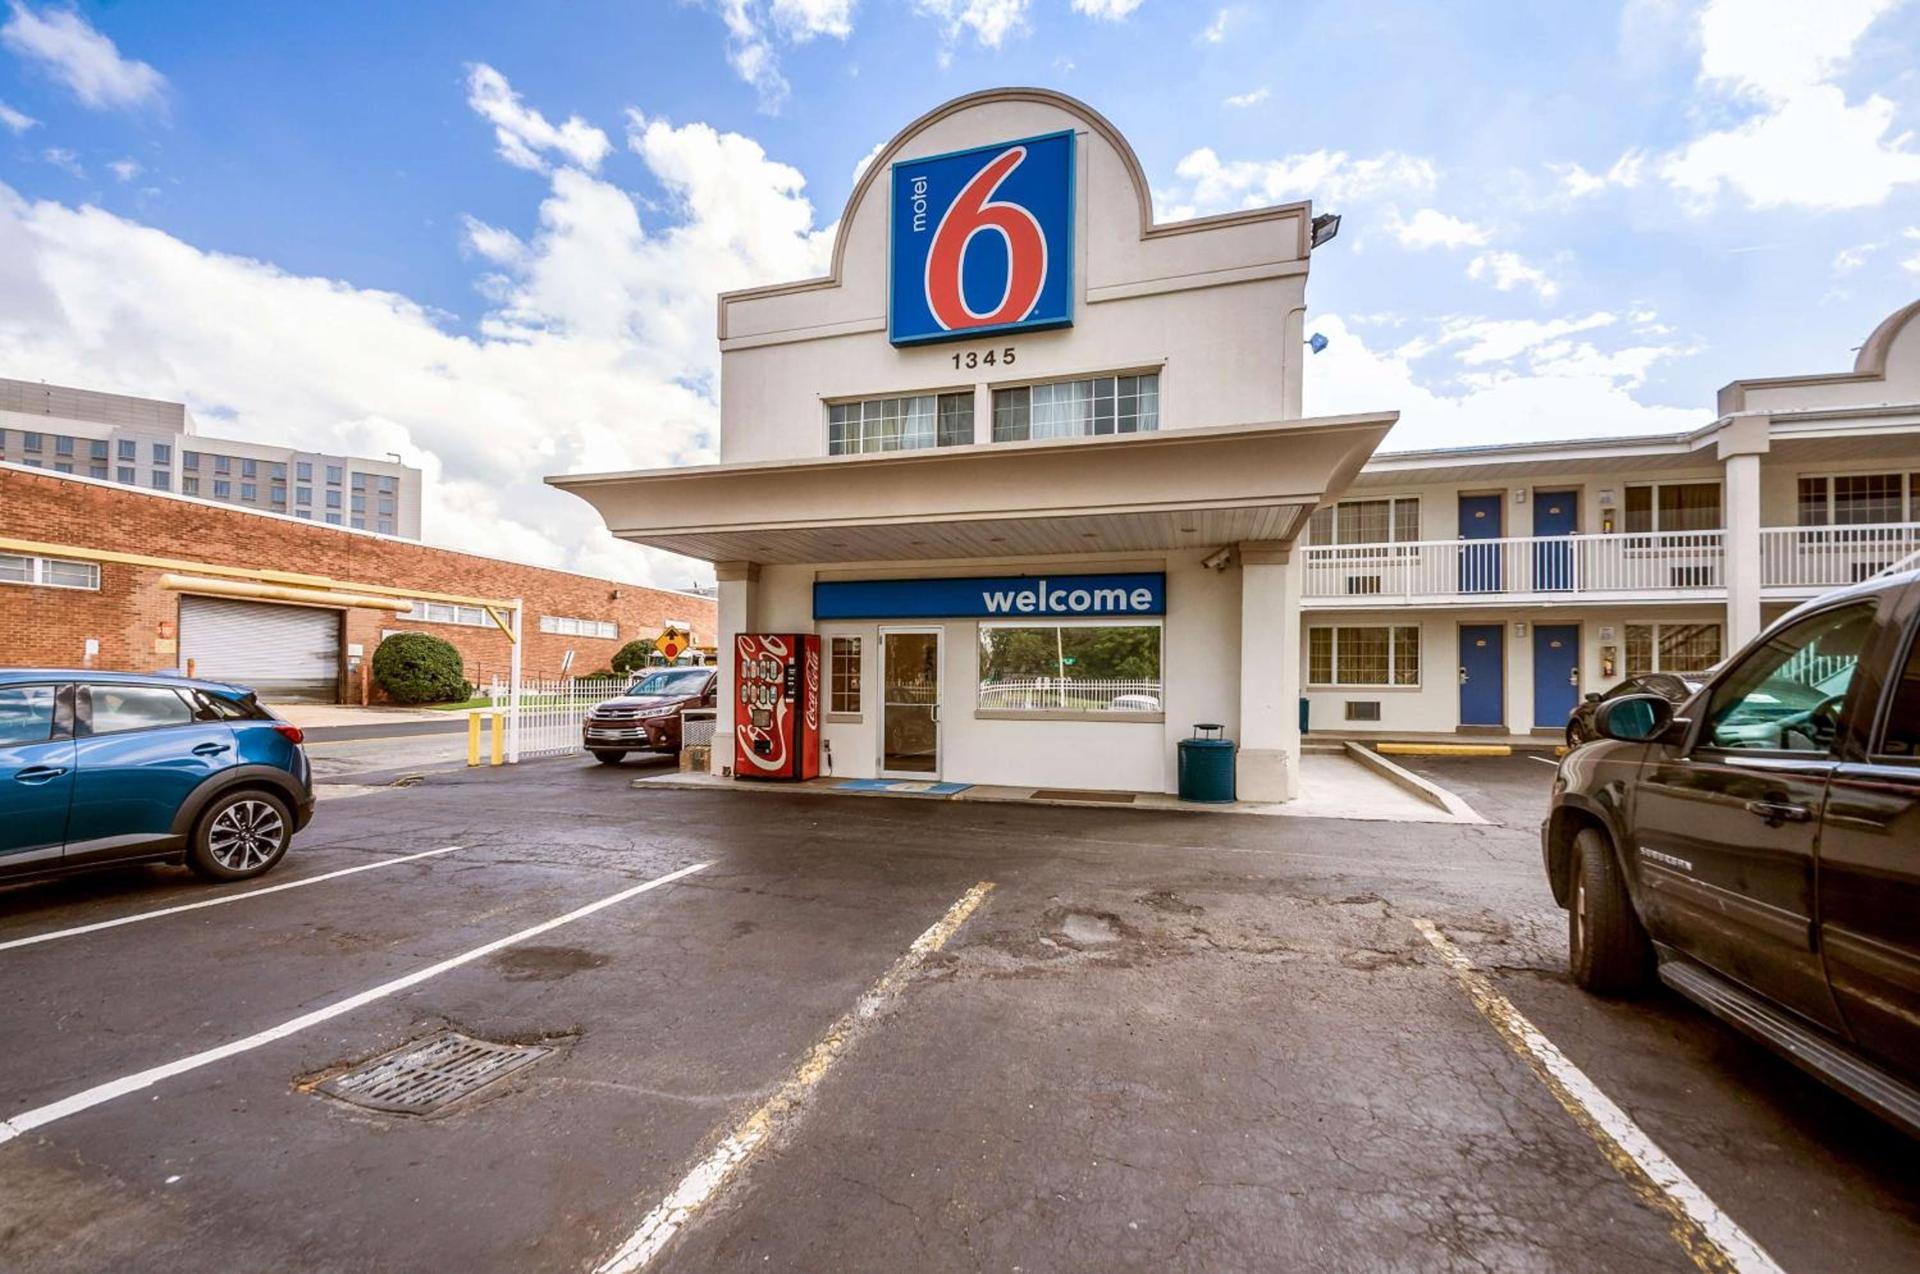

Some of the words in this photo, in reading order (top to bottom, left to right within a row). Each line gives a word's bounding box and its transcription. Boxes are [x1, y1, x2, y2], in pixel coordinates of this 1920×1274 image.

[911, 176, 927, 233] motel
[924, 145, 1048, 330] 6
[952, 347, 1016, 370] 1345
[982, 580, 1153, 614] welcome
[805, 647, 819, 731] Coca-Cola
